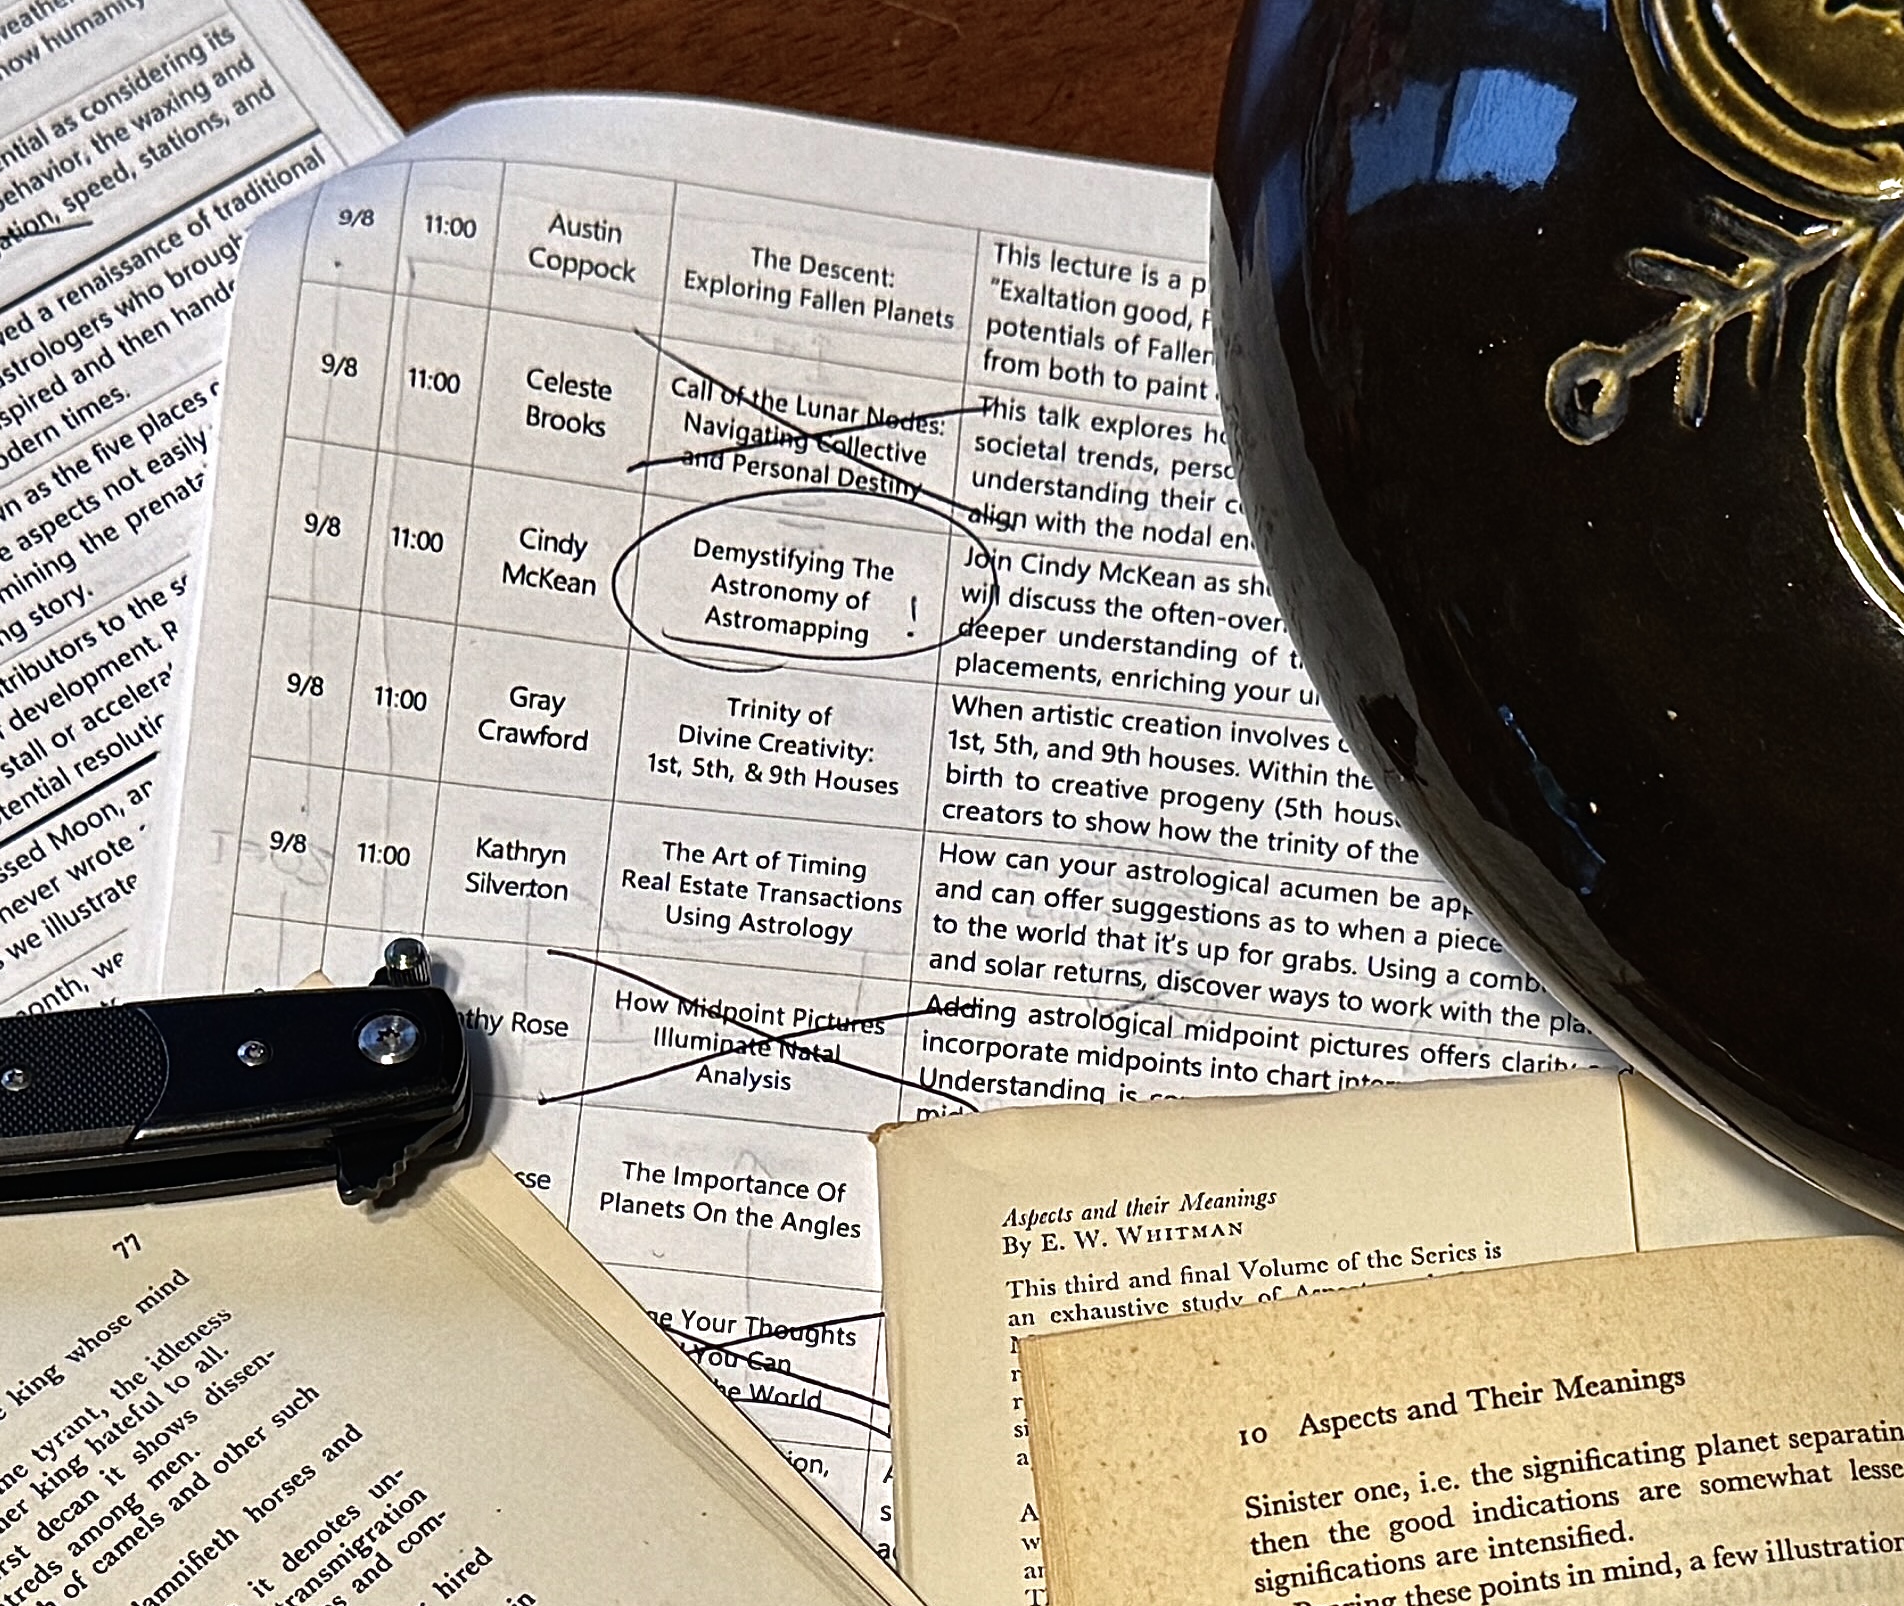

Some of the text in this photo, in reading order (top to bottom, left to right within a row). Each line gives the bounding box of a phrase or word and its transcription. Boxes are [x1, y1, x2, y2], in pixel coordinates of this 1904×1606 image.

[338, 208, 375, 228] 9/8
[425, 214, 477, 239] 11:00
[548, 212, 622, 245] Austin
[528, 246, 636, 284] Coppock
[751, 246, 895, 289] The Descent:
[526, 367, 613, 401] Celeste
[526, 404, 606, 438] Brooks
[519, 527, 589, 563] Cindy
[693, 537, 895, 582] Demystifying The
[502, 561, 597, 596] McKean
[710, 573, 871, 612] Astronomy of
[704, 605, 869, 649] Astromapping
[509, 685, 567, 718] Gray
[727, 697, 833, 728] Trinity of
[952, 694, 1222, 740] When artistic creation
[478, 718, 589, 751] Crawford
[678, 723, 874, 766] Divine Creativity:
[648, 753, 899, 796] 1st, 5th, & 9th Houses
[476, 837, 566, 869] Kathryn
[662, 841, 866, 883] The Art of Timing
[465, 871, 568, 901] Silverton
[622, 1160, 846, 1203] The Importance Of
[1002, 1187, 1277, 1231] Aspects and their Meanings
[112, 1233, 141, 1259] 77
[1002, 1236, 1031, 1259] By
[1041, 1233, 1065, 1253] E.
[1073, 1229, 1108, 1250] W.
[6, 1364, 65, 1407] king
[64, 1314, 132, 1363] whose
[135, 1268, 190, 1314] mind
[1239, 1371, 1686, 1446] 10 Aspects and Their Meanings
